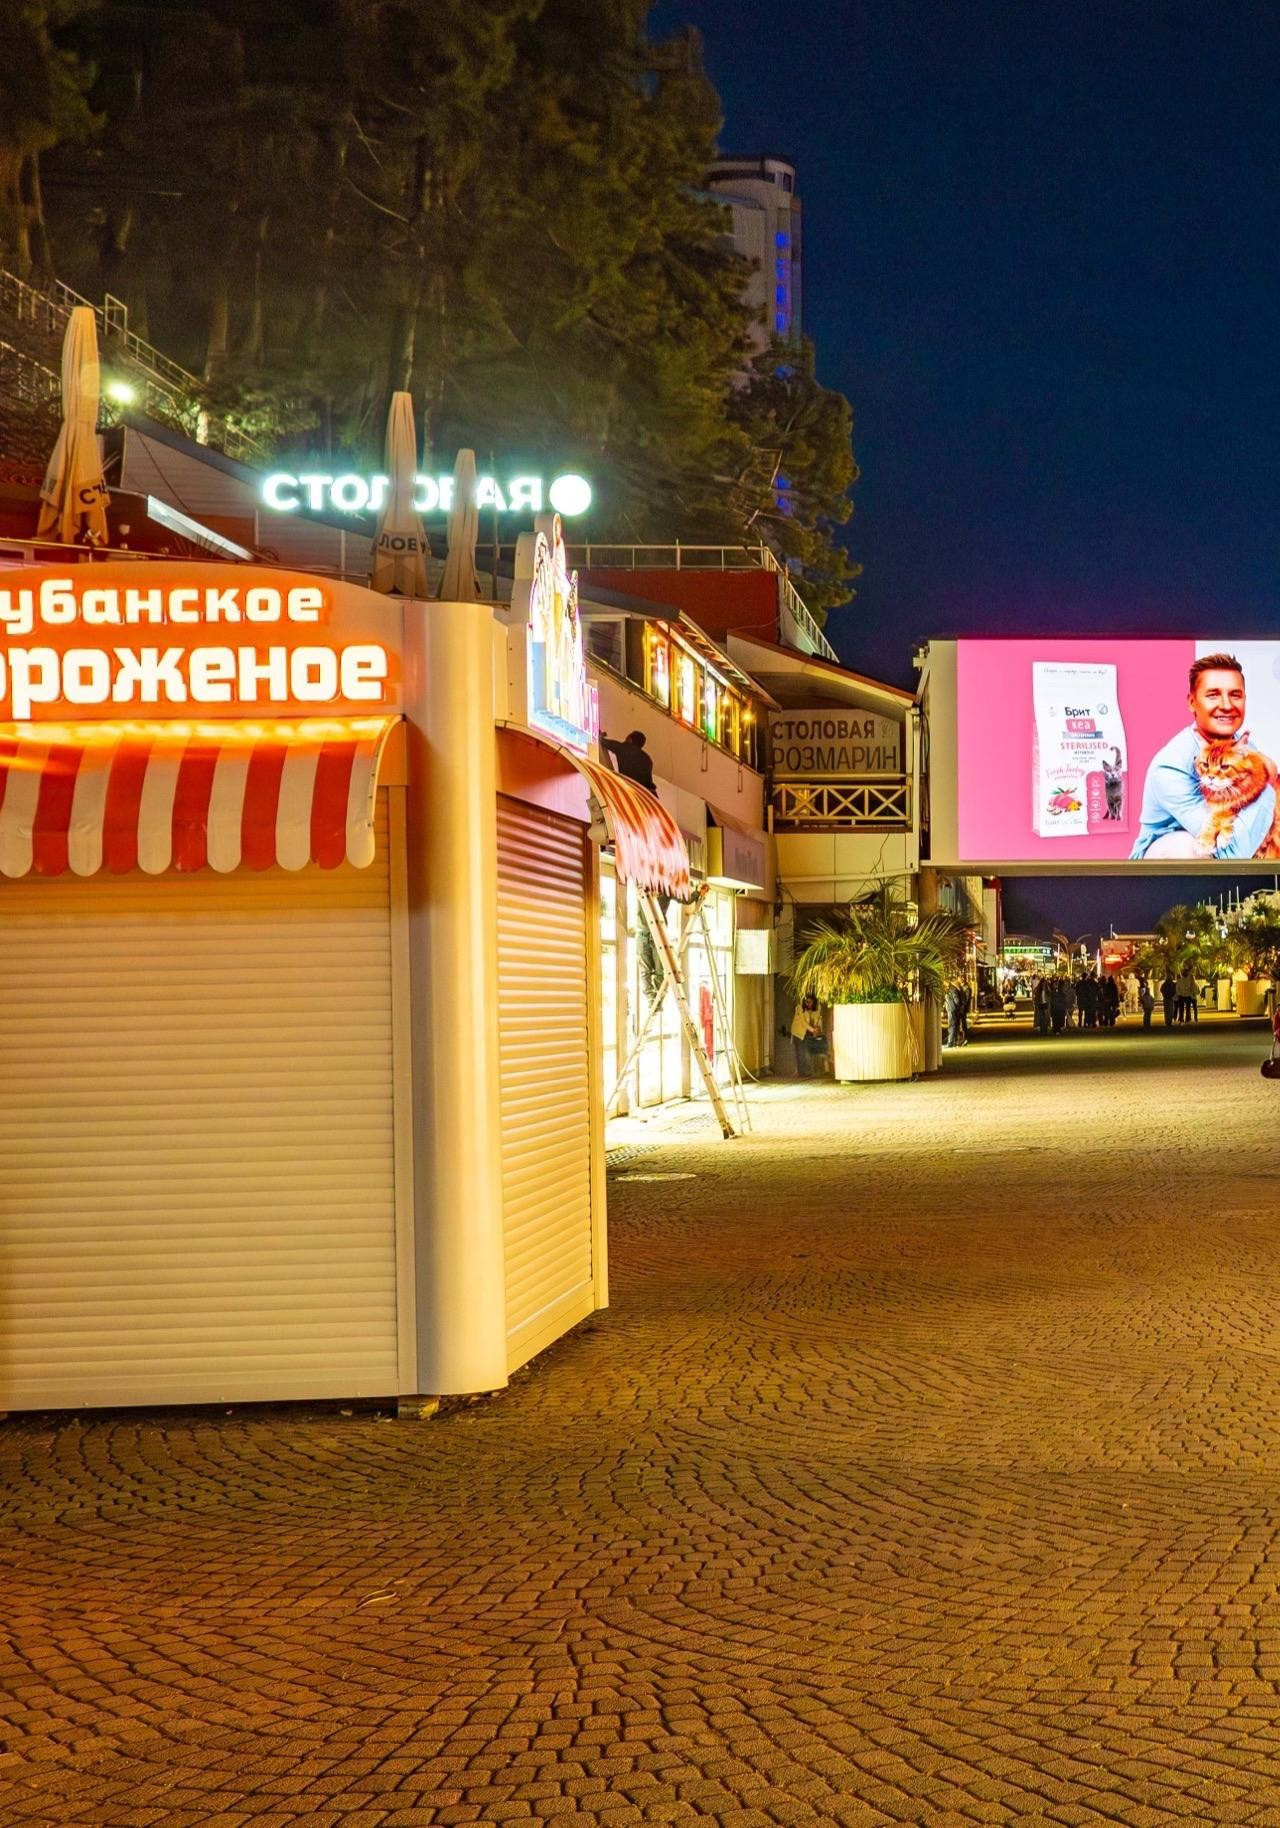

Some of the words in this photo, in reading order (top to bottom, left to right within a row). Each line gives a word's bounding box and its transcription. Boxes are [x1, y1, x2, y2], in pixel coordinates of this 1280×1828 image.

[0, 645, 387, 719] роженое
[1064, 706, 1090, 718] Брит
[774, 720, 875, 740] СТОЛОВАЯ
[773, 746, 897, 771] РОЗМАРИН
